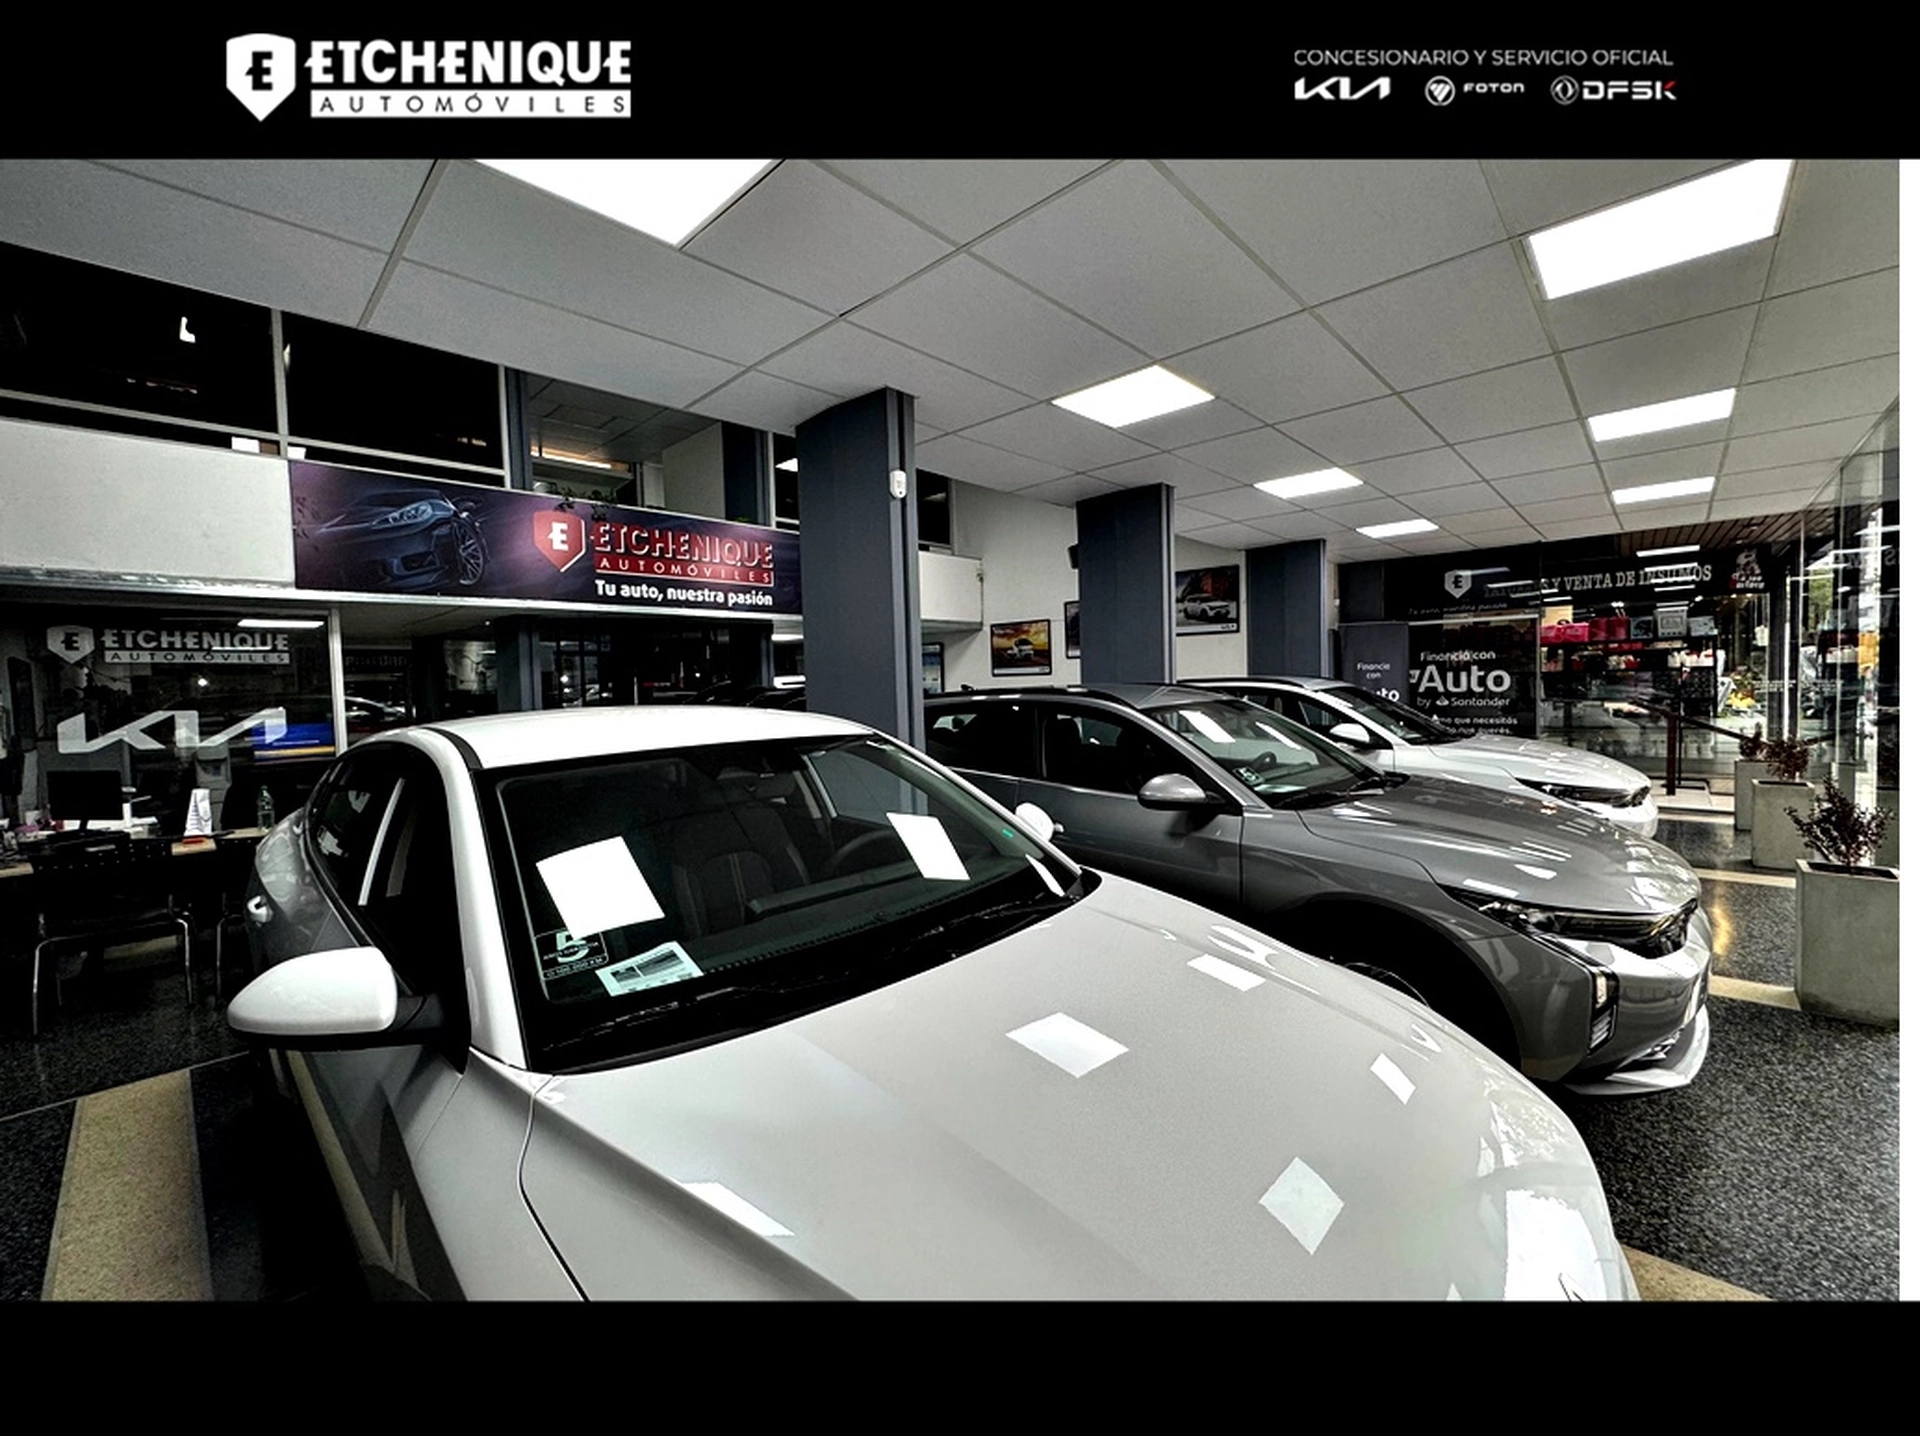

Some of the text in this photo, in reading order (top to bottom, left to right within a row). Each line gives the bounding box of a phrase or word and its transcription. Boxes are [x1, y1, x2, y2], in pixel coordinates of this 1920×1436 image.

[590, 521, 774, 569] ETCHENIQUE
[600, 556, 771, 584] AUTOMÓVILES
[1551, 577, 1561, 590] Y
[1563, 573, 1613, 591] VENTA
[1615, 570, 1636, 588] DE
[594, 580, 773, 607] Tu auto, nuestra pasión
[101, 628, 289, 651] ETCHENIQUE
[110, 651, 286, 663] AUTOMÓVILES
[1473, 651, 1496, 660] con
[1366, 672, 1382, 680] con
[1417, 664, 1512, 693] Auto
[1416, 696, 1511, 710] by Santander
[57, 706, 288, 754] KIA
[1454, 718, 1472, 726] que
